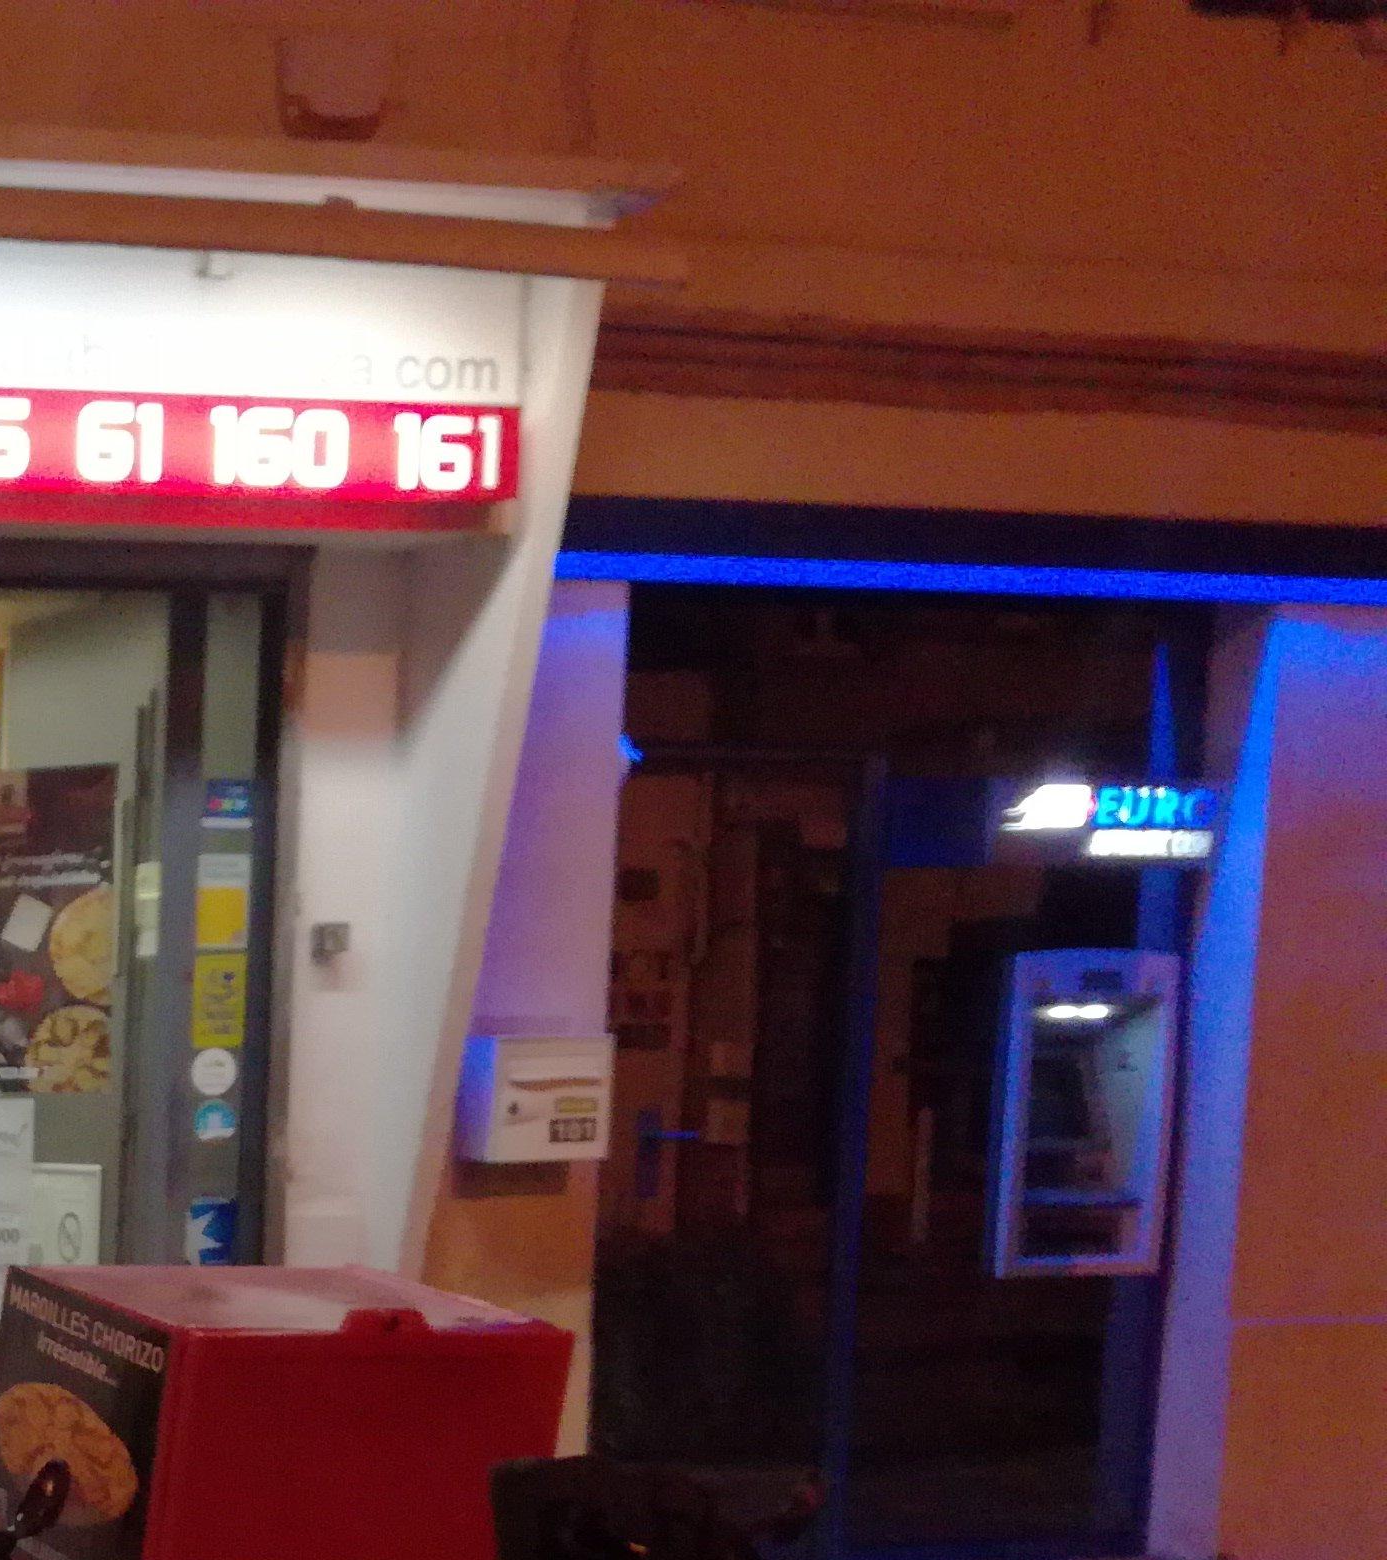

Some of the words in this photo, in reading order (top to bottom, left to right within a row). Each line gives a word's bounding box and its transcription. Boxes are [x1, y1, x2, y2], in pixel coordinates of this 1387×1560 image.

[75, 401, 165, 484] 61
[209, 405, 350, 488] 160
[393, 411, 501, 492] 161
